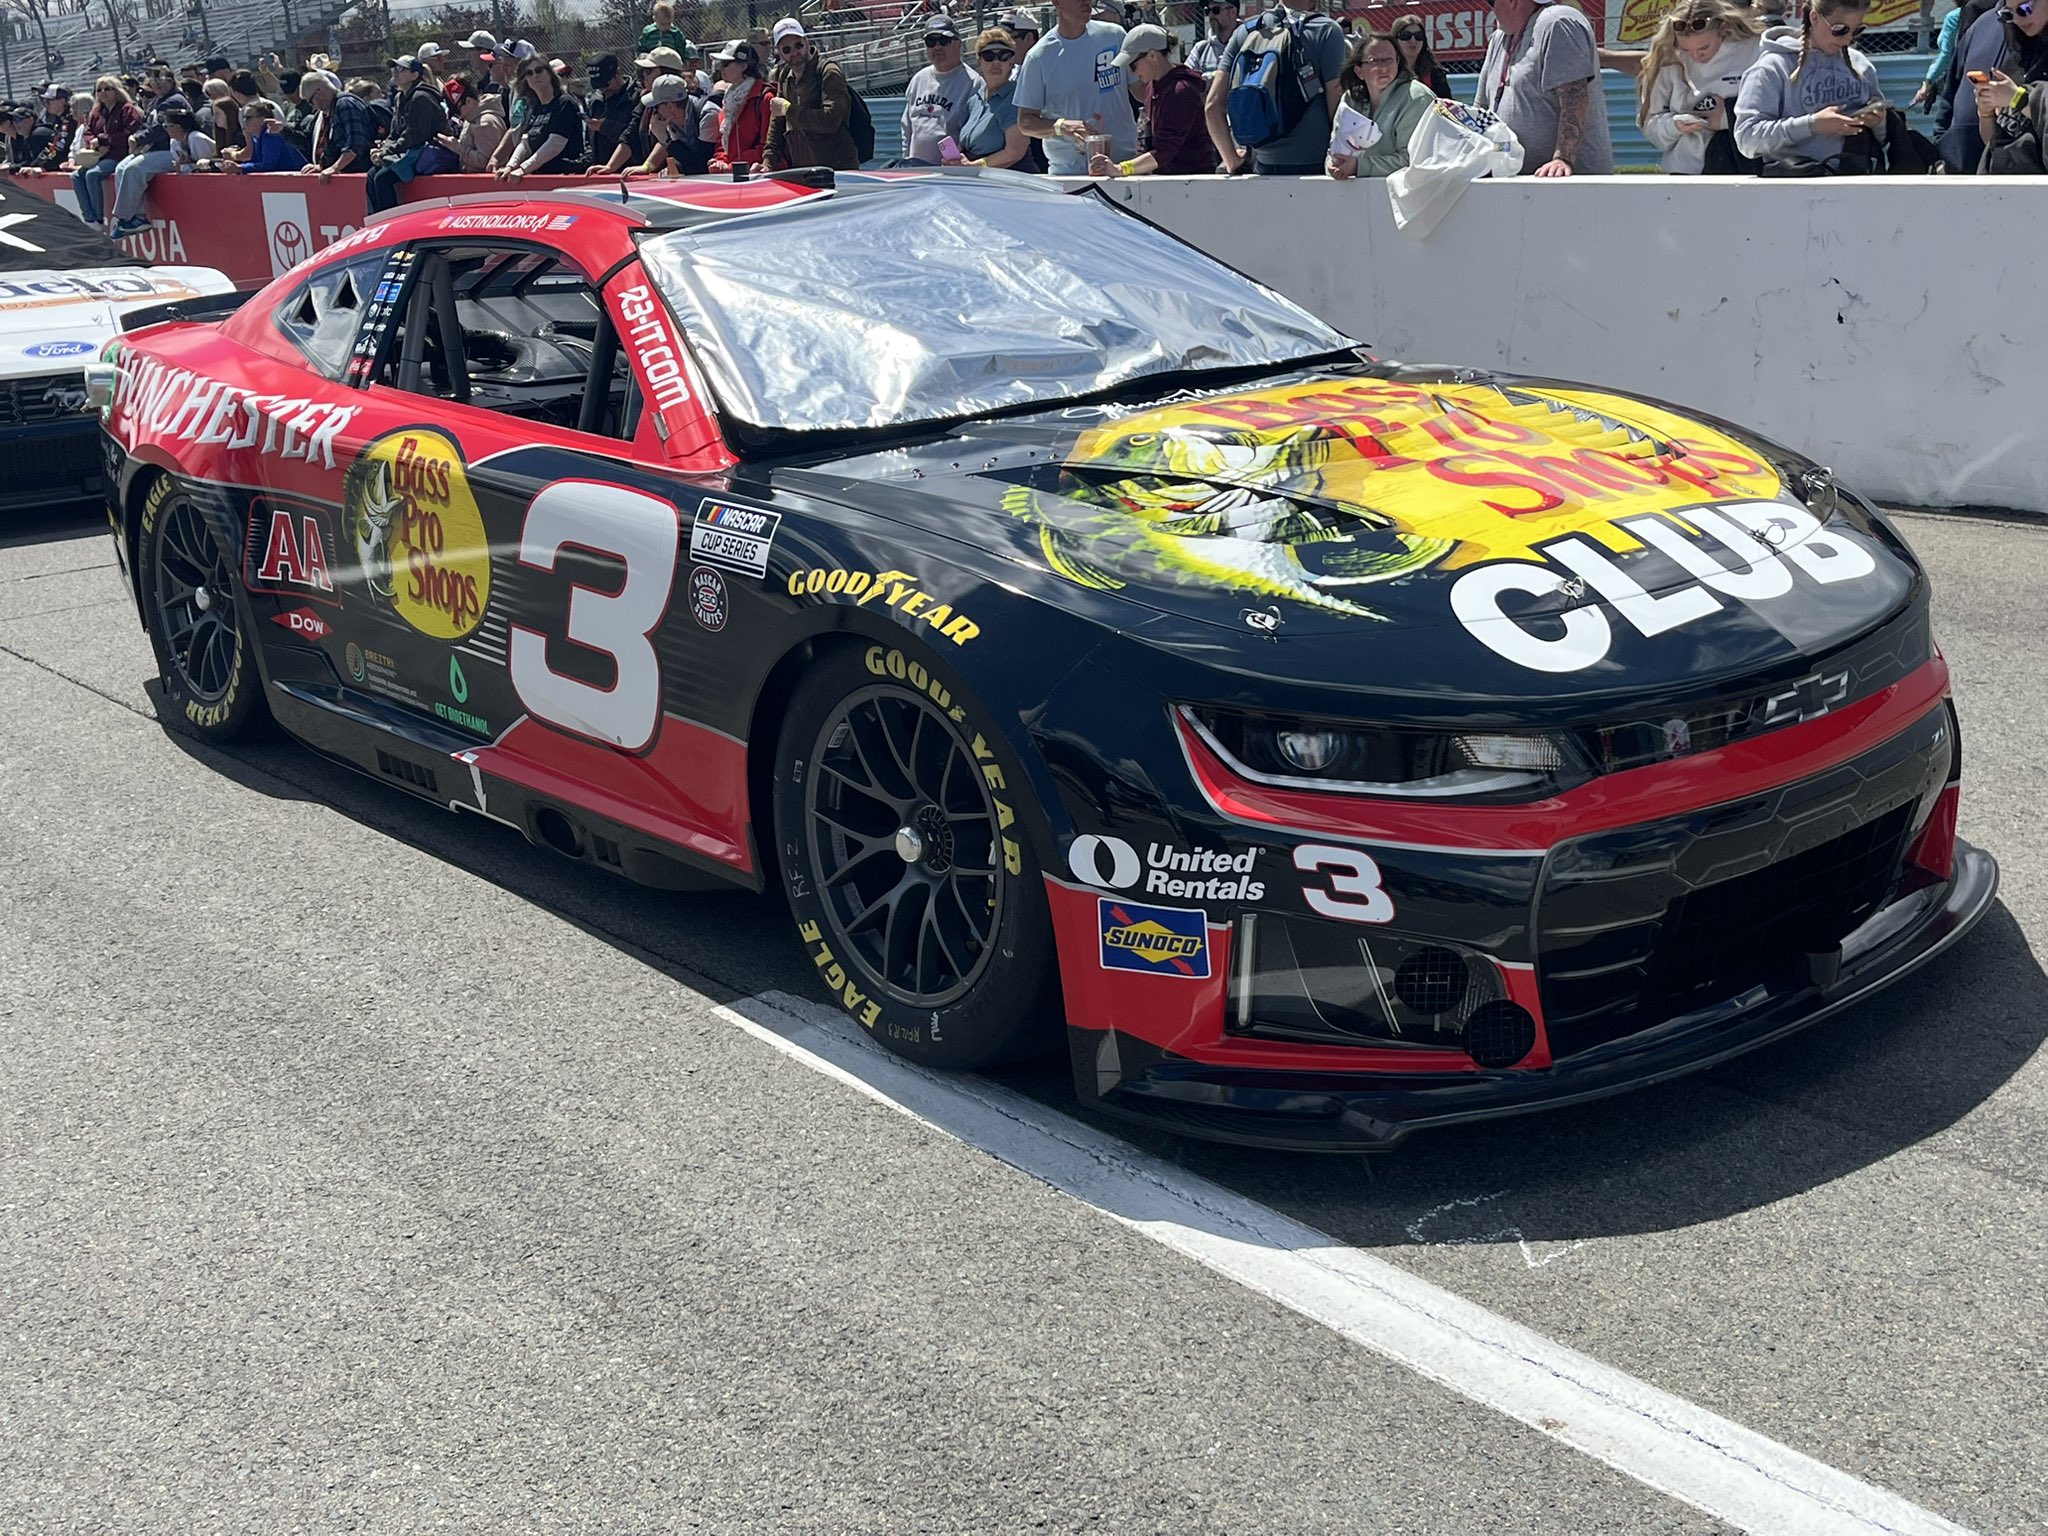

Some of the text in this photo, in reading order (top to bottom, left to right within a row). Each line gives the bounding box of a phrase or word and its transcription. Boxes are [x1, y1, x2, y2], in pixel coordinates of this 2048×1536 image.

[1097, 51, 1114, 72] 9
[916, 94, 954, 112] CANADA
[38, 342, 84, 358] Ford
[116, 346, 352, 471] WINCHESTER
[394, 437, 450, 501] Bass
[1425, 437, 1763, 519] Shops
[142, 473, 172, 534] EAGLE
[400, 494, 444, 555] Pro
[719, 508, 767, 534] NASCAR
[258, 510, 334, 592] AA
[700, 533, 759, 561] CUP SERIES
[408, 547, 480, 627] Shops
[694, 574, 722, 595] NASCAR
[699, 592, 718, 606] 250
[1450, 498, 1876, 673] CLUB
[510, 478, 680, 754] 3
[694, 602, 723, 625] SALUTES
[788, 568, 981, 647] GOODYEAR
[365, 649, 395, 669] BREZTRI
[434, 702, 448, 719] GET
[1146, 843, 1257, 874] United
[1145, 870, 1265, 900] Rentals
[1293, 844, 1395, 923] 3
[1108, 928, 1199, 954] SUNOCO
[798, 919, 882, 1029] EAGLE
